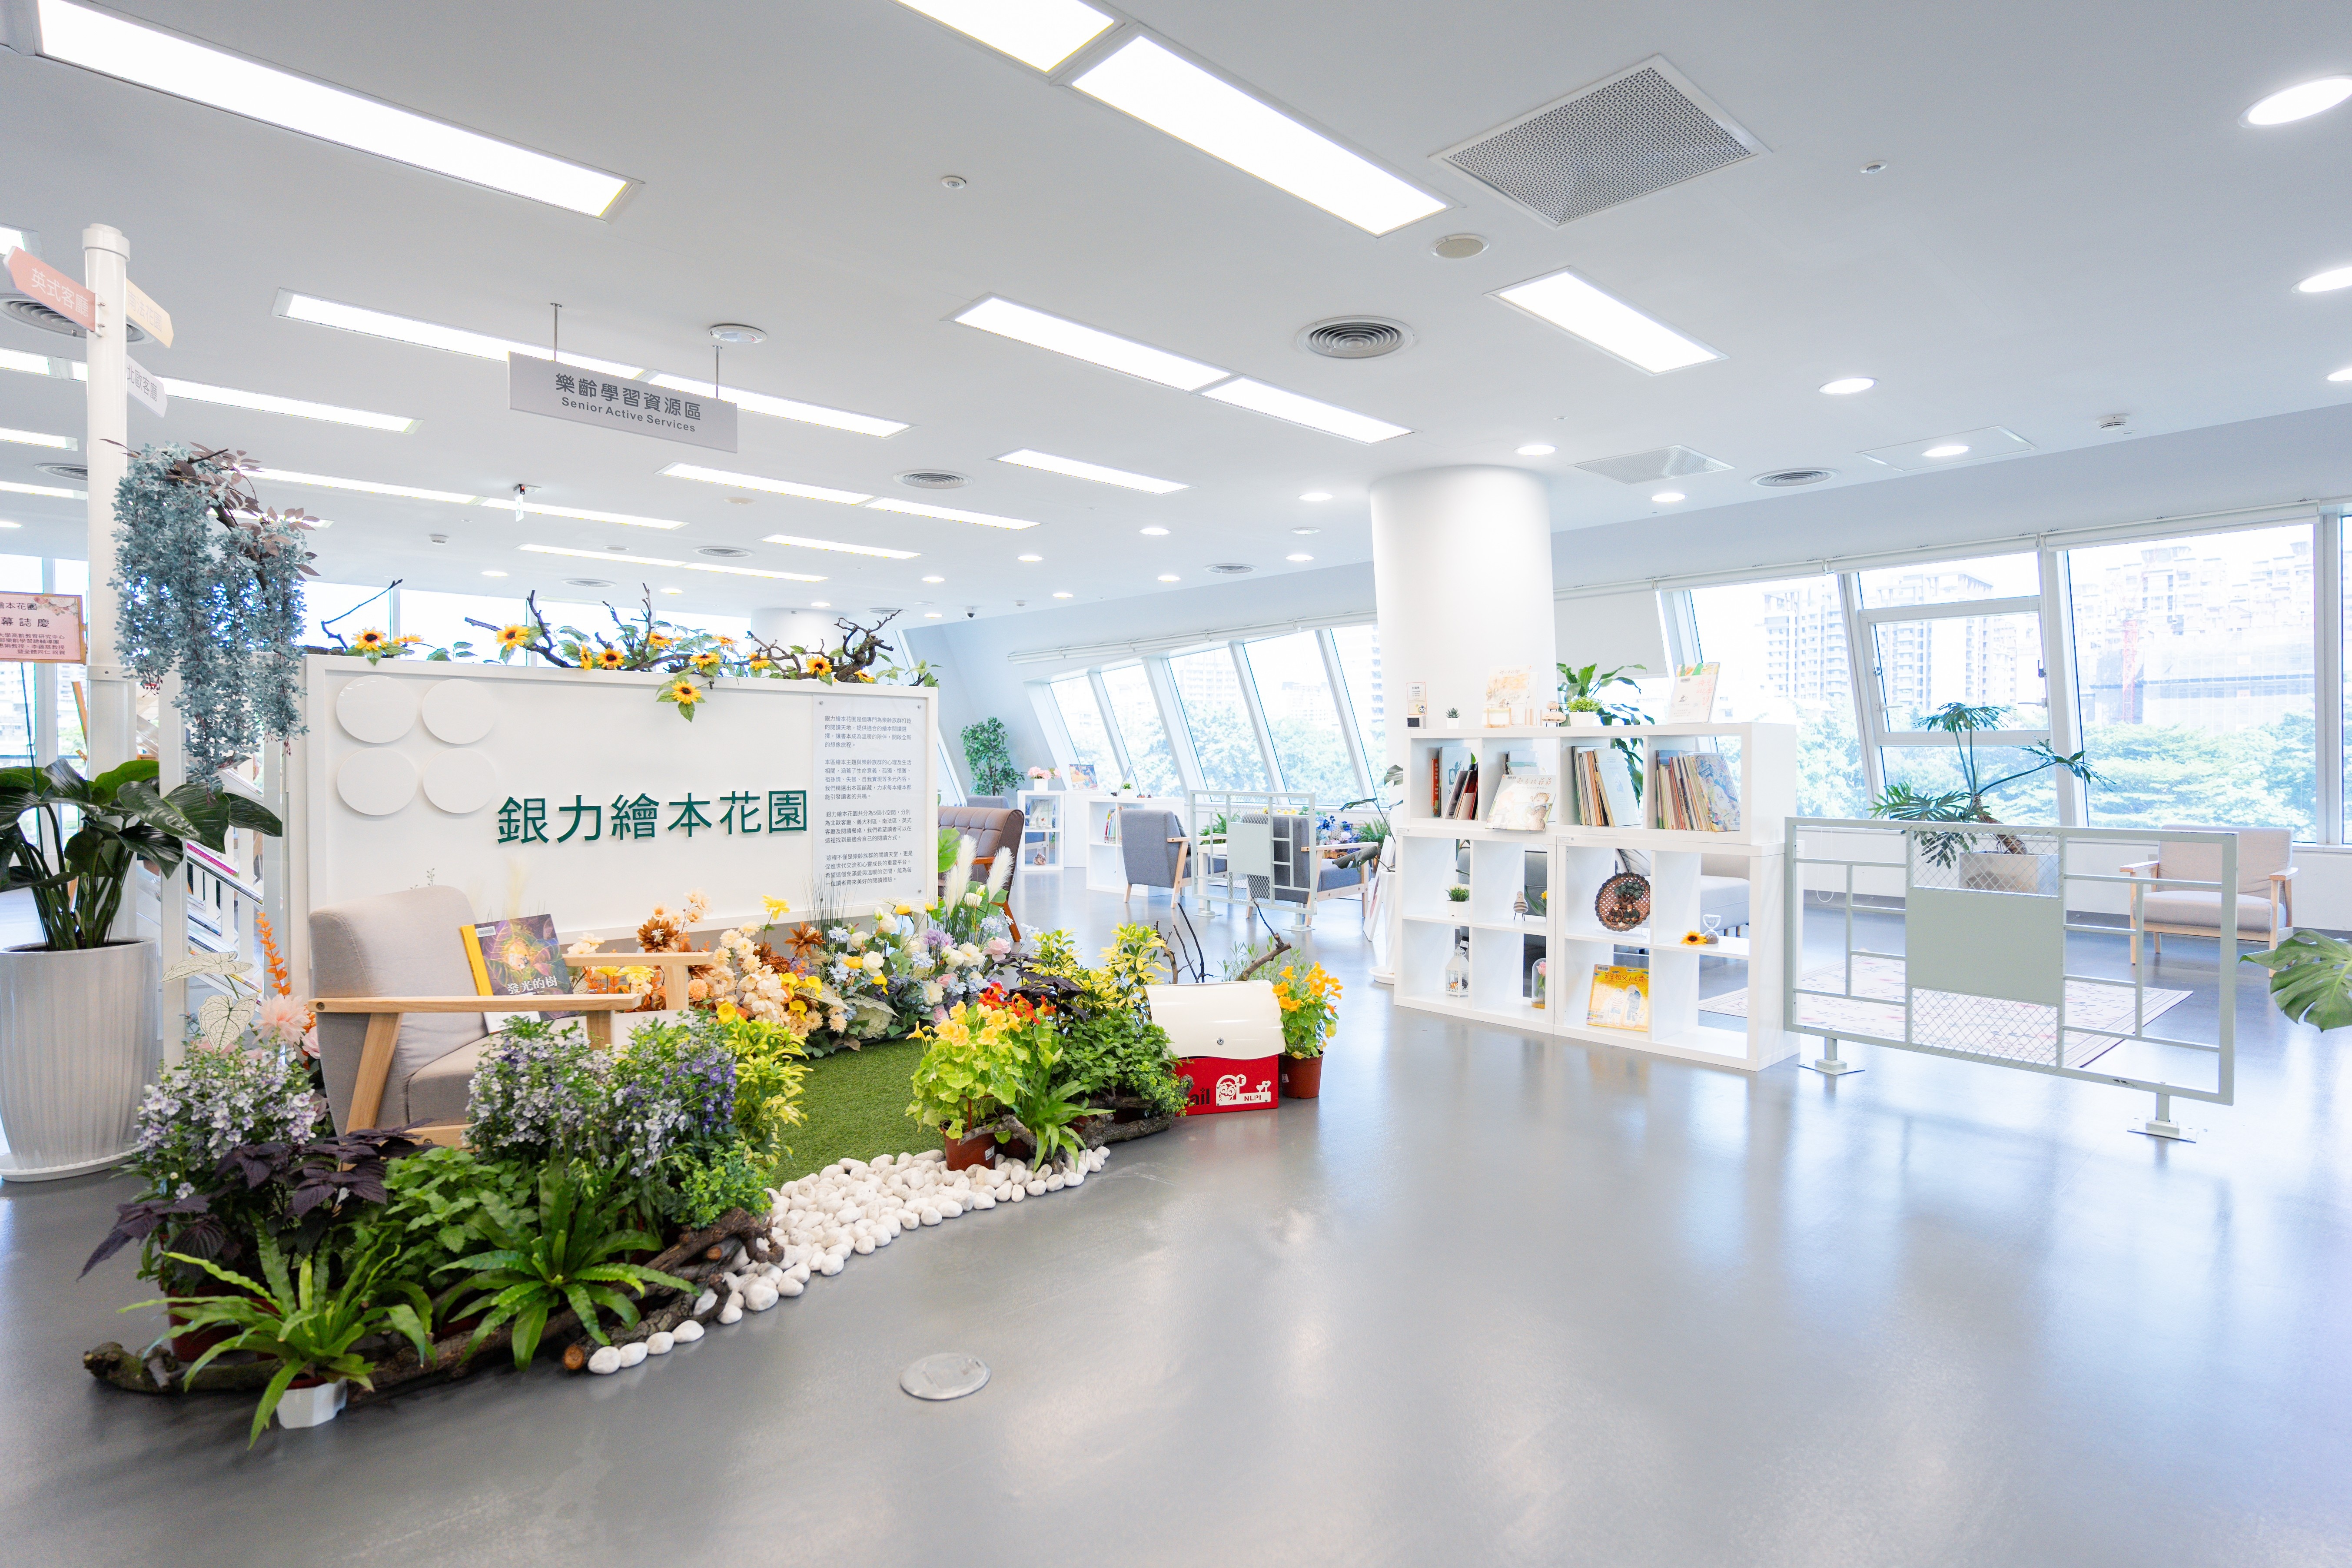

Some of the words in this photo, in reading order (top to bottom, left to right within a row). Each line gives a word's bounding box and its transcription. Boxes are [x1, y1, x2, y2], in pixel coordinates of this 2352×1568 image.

[31, 268, 89, 318] 英式客廳
[128, 290, 162, 332] 南法花園
[127, 364, 158, 402] 北歐客廳
[555, 373, 701, 421] 樂齡學習資源區
[561, 397, 603, 413] Senior
[605, 406, 643, 422] Active
[646, 415, 696, 432] Services
[1, 617, 50, 628] 幕誌慶
[496, 790, 807, 844] 銀力繪本花園
[507, 975, 558, 995] 發光的樹
[1185, 1088, 1210, 1106] ail
